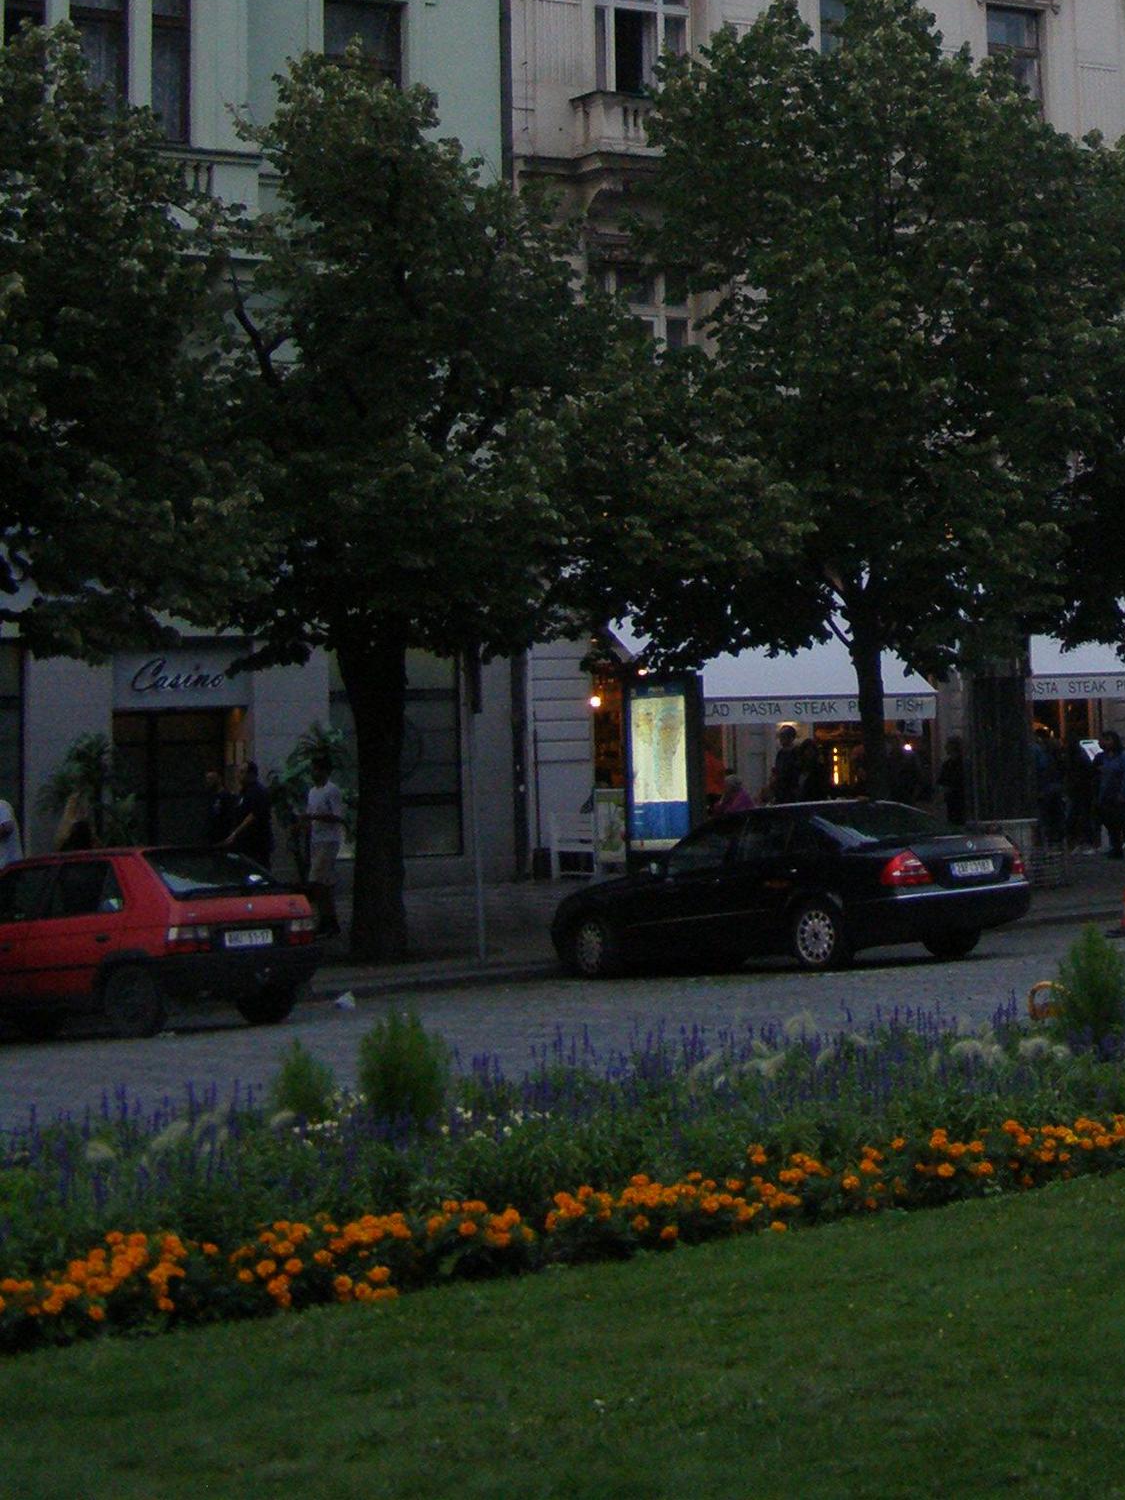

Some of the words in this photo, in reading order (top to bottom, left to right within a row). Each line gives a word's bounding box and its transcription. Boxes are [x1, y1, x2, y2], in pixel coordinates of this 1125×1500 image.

[131, 656, 226, 693] Casino
[1068, 679, 1107, 693] STEAK
[743, 702, 783, 717] PASTA
[793, 700, 838, 716] STEAK
[896, 699, 924, 713] FISH
